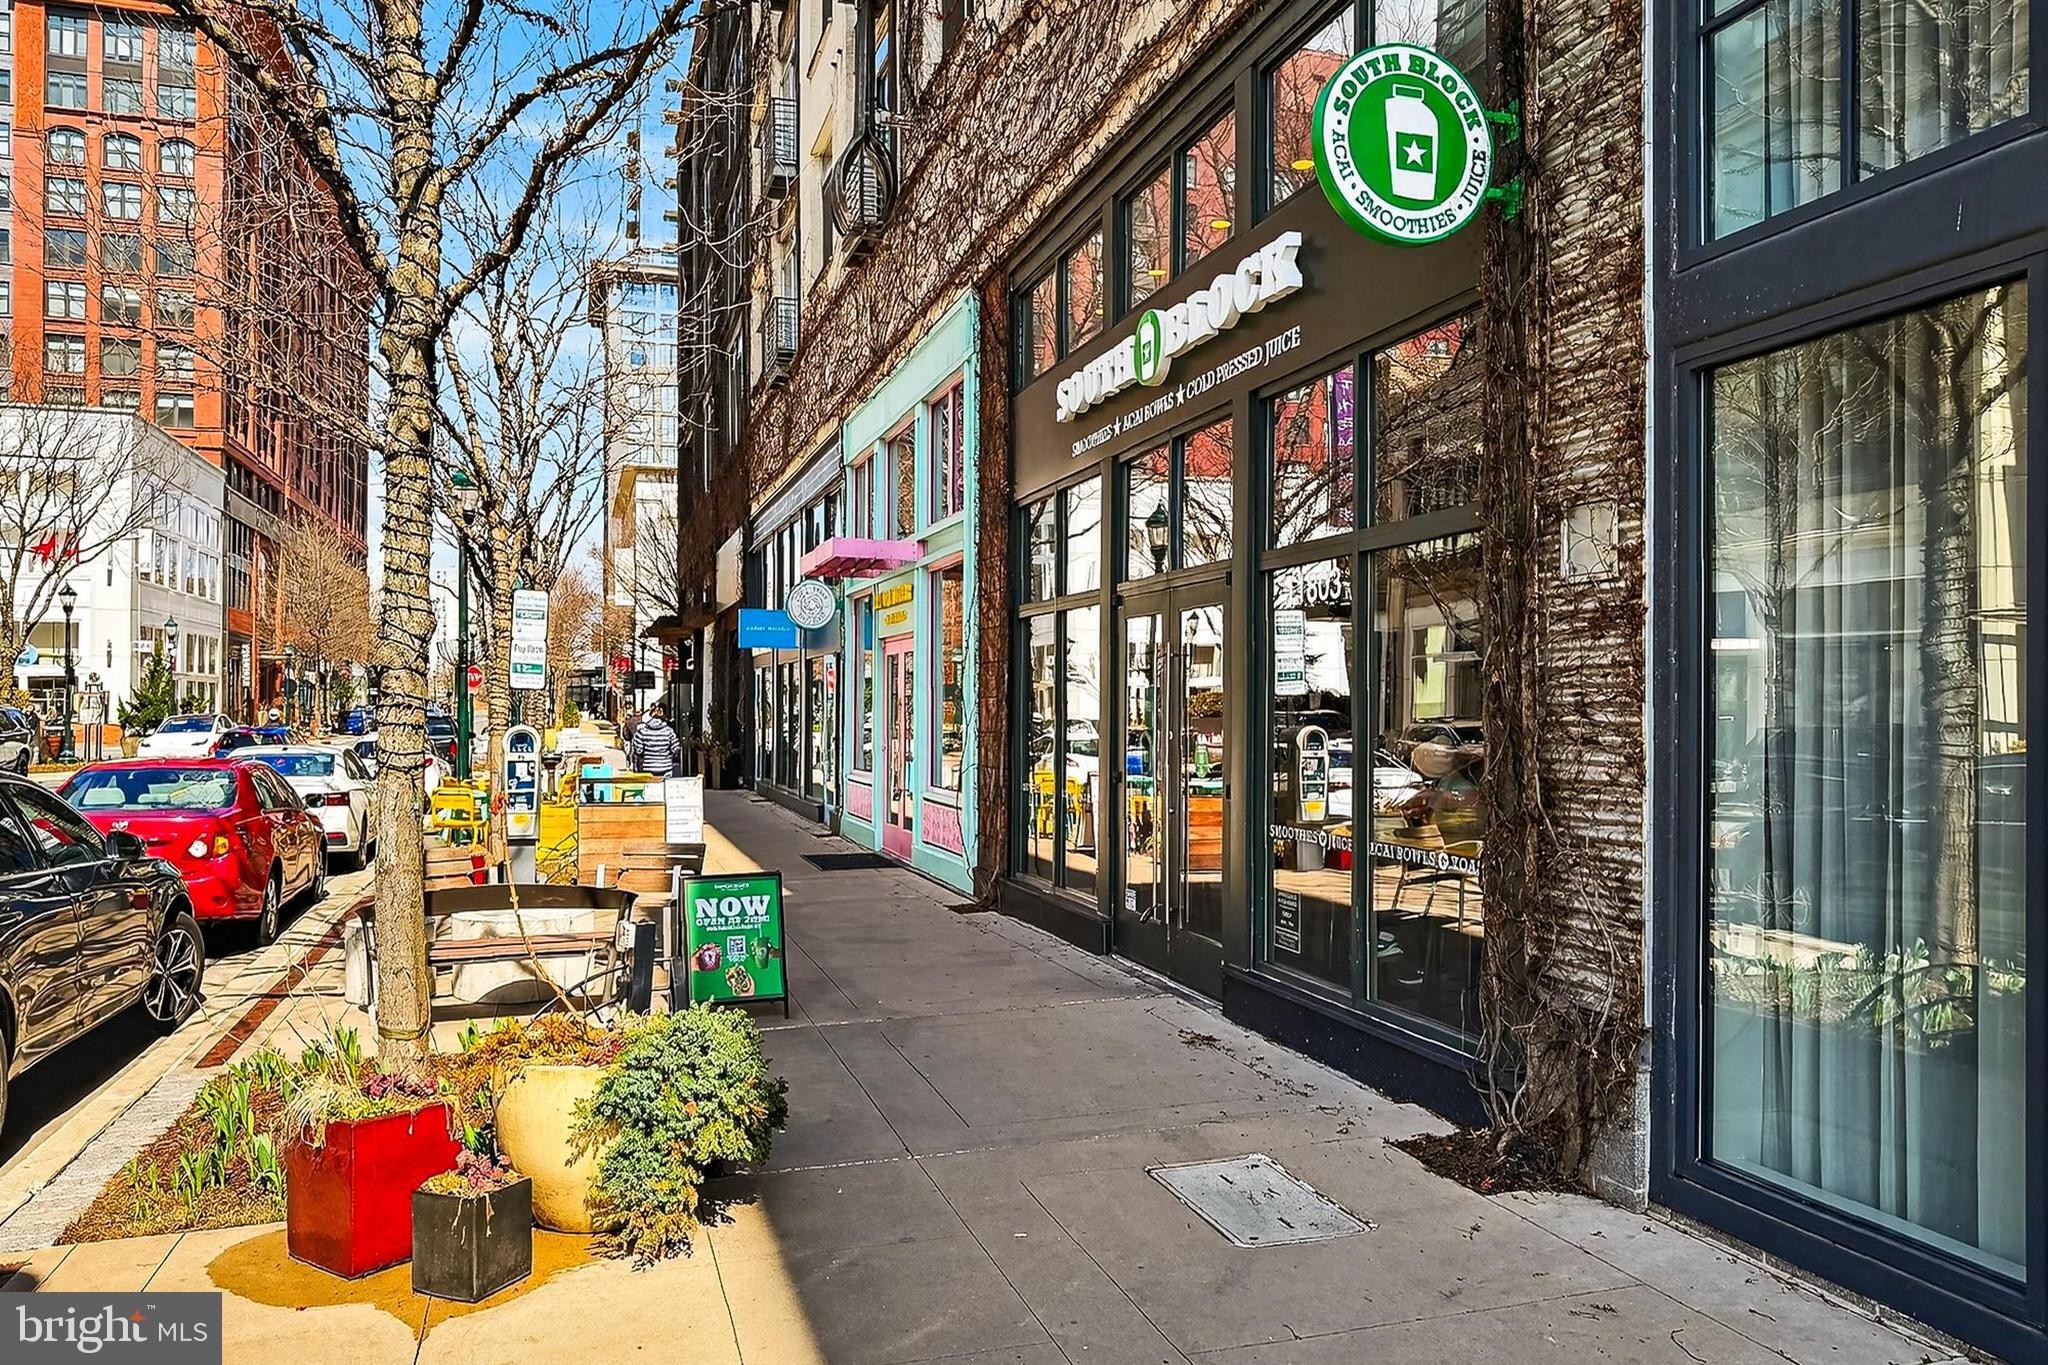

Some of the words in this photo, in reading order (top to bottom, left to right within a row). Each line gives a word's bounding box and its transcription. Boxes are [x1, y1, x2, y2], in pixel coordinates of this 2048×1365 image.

[1334, 54, 1402, 116] SOUTH
[1408, 54, 1483, 132] BLOCK
[1356, 189, 1457, 235] SMOOTHIES
[1460, 149, 1486, 207] JUICE
[1056, 334, 1137, 423] SOUTH
[1164, 231, 1303, 358] BLOCK
[1144, 391, 1174, 422] BOWLS
[1186, 370, 1215, 399] COLD
[1216, 345, 1263, 385] PRESSED
[1263, 324, 1301, 367] JUICE
[694, 894, 771, 918] NOW
